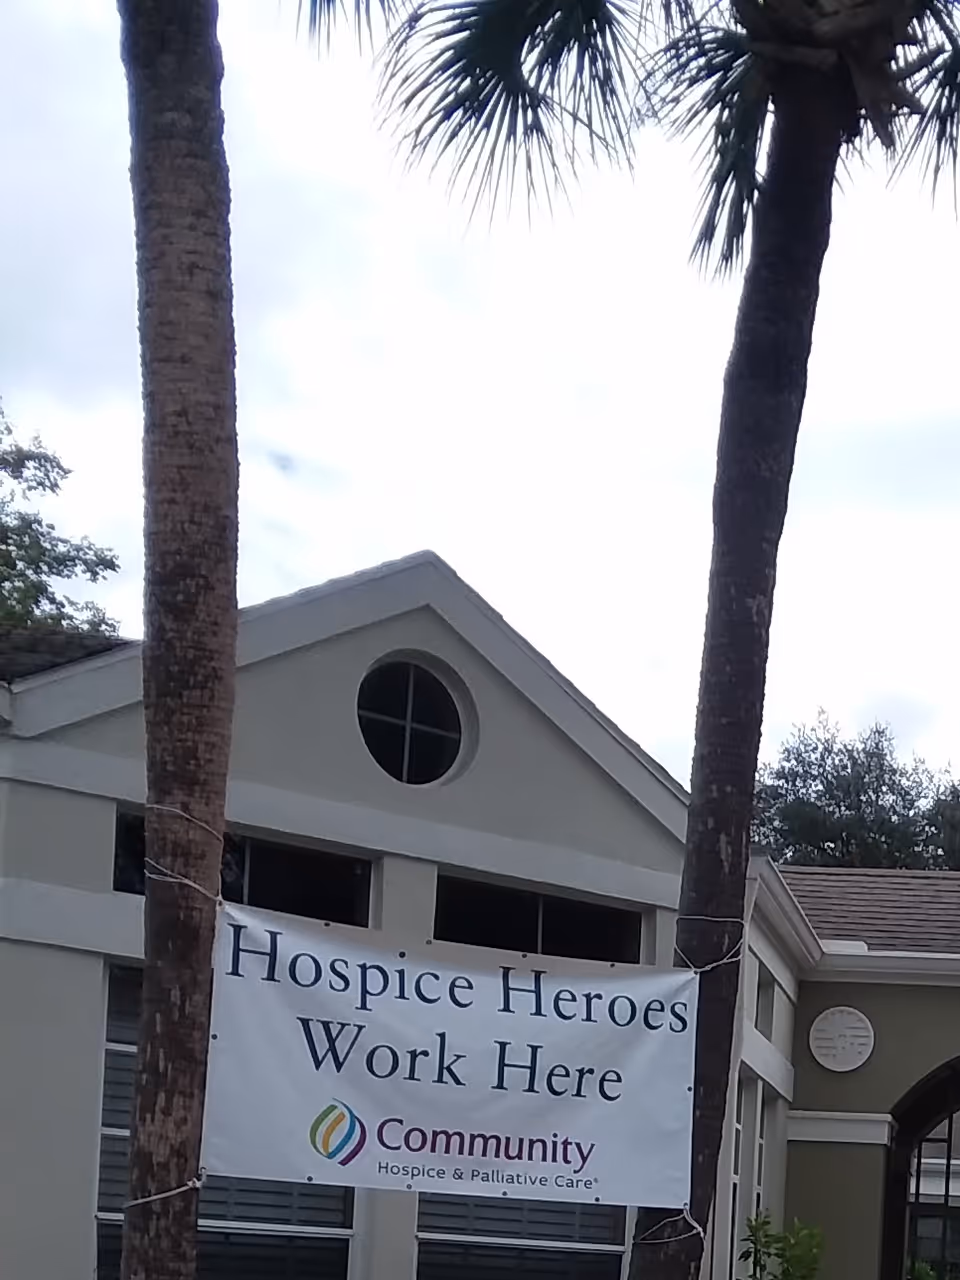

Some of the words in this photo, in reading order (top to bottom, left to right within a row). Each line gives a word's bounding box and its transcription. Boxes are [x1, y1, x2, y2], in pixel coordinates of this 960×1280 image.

[226, 923, 475, 1012] Hospice
[498, 965, 689, 1033] Heroes
[297, 1016, 467, 1087] Work
[491, 1040, 623, 1101] Here
[376, 1117, 596, 1174] Community
[378, 1161, 446, 1180] Hospice
[452, 1168, 464, 1180] &
[470, 1169, 548, 1187] Palliative
